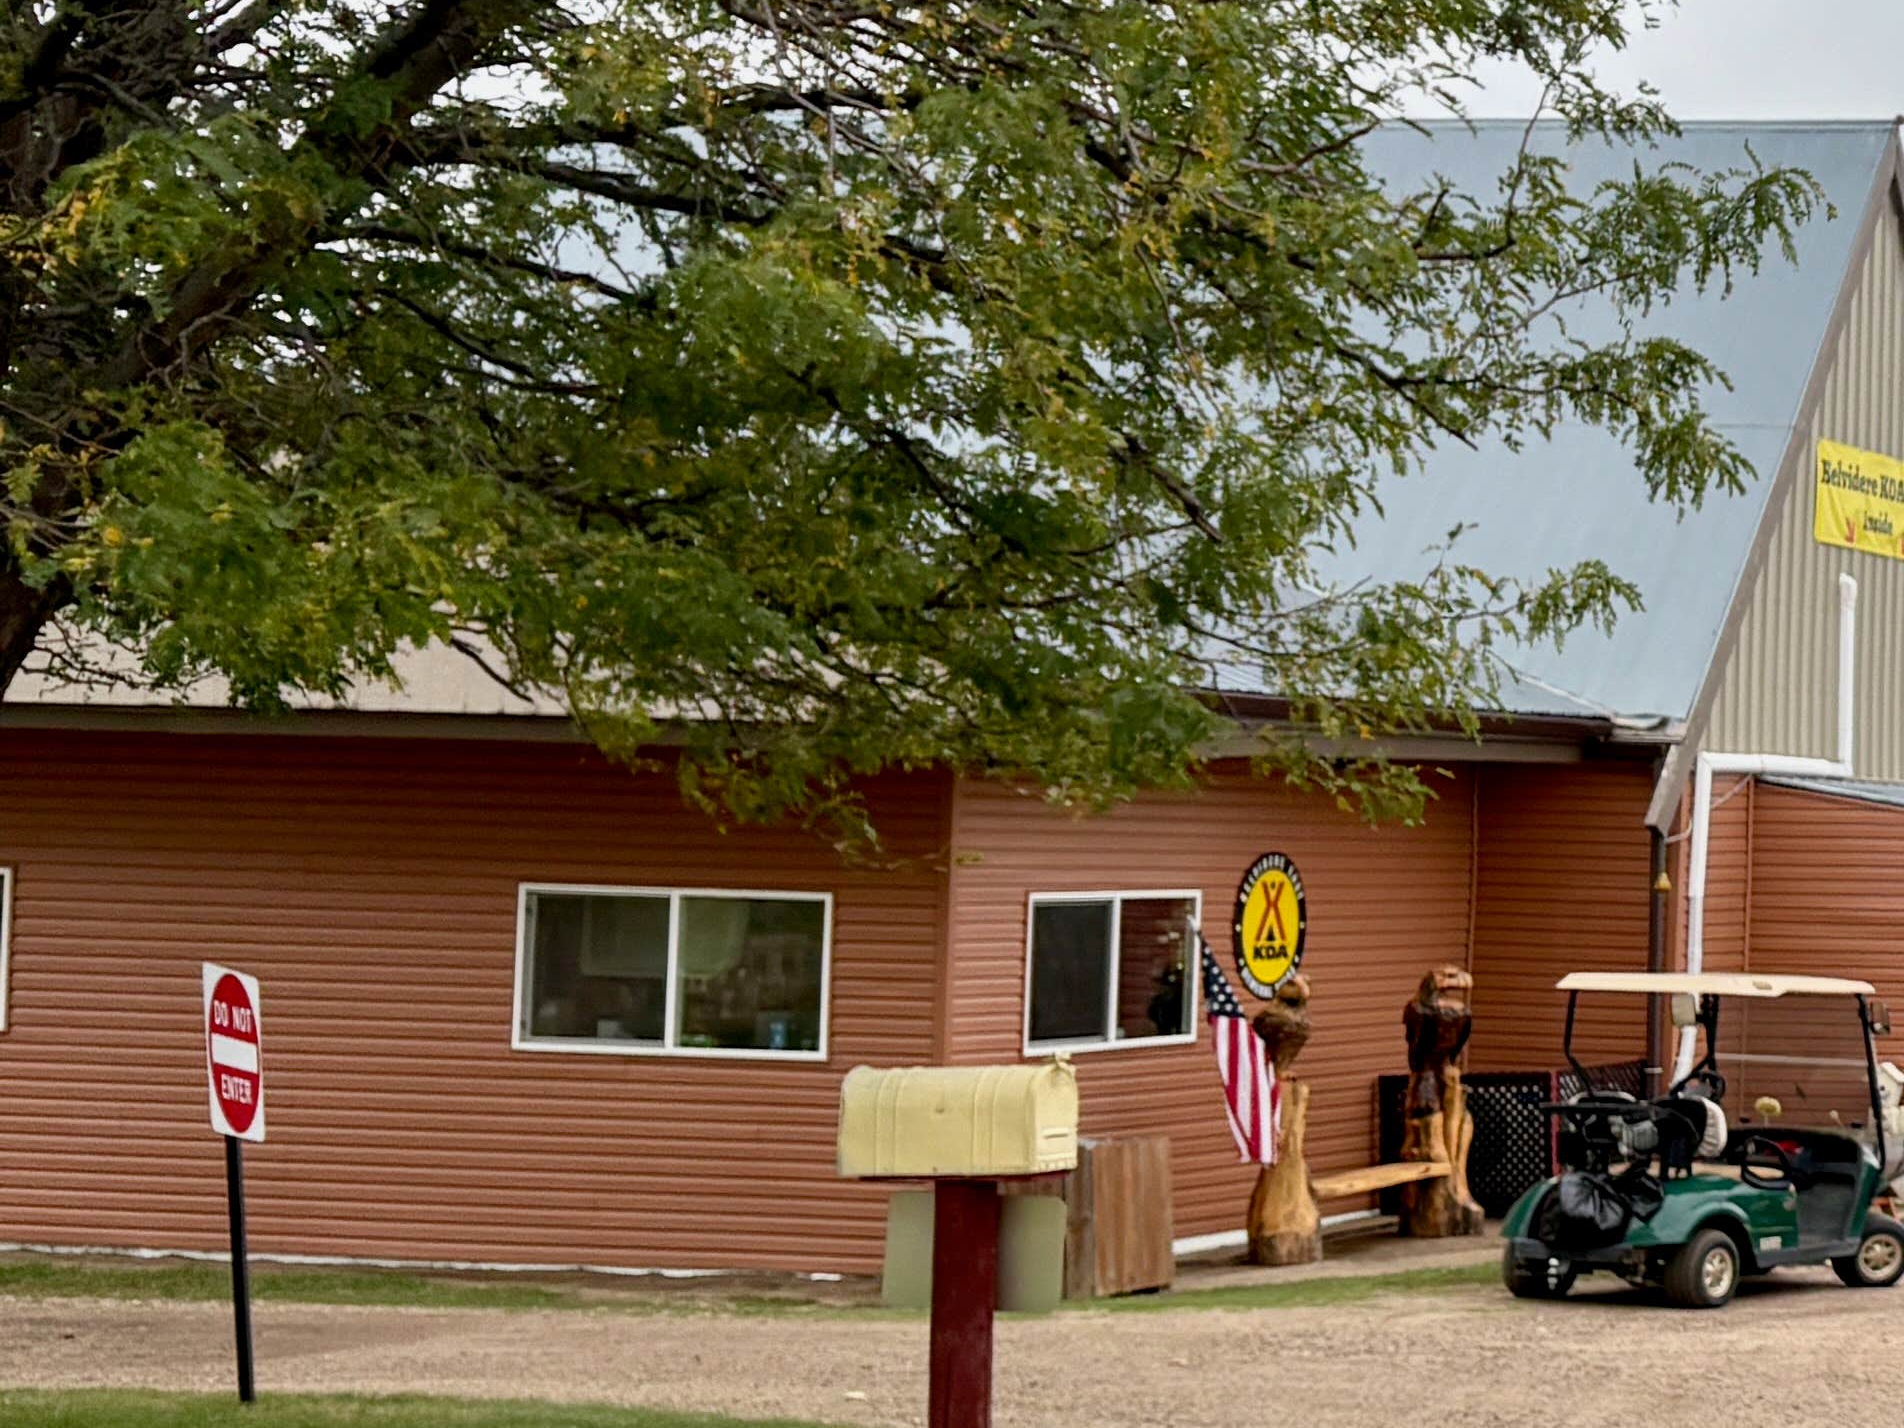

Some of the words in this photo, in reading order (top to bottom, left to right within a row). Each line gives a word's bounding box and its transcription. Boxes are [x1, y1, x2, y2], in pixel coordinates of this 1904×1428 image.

[1820, 459, 1878, 497] Belvidere
[1253, 944, 1288, 960] KOA
[213, 1000, 228, 1028] DO
[232, 1006, 251, 1034] NOT
[221, 1074, 252, 1104] ENTER
